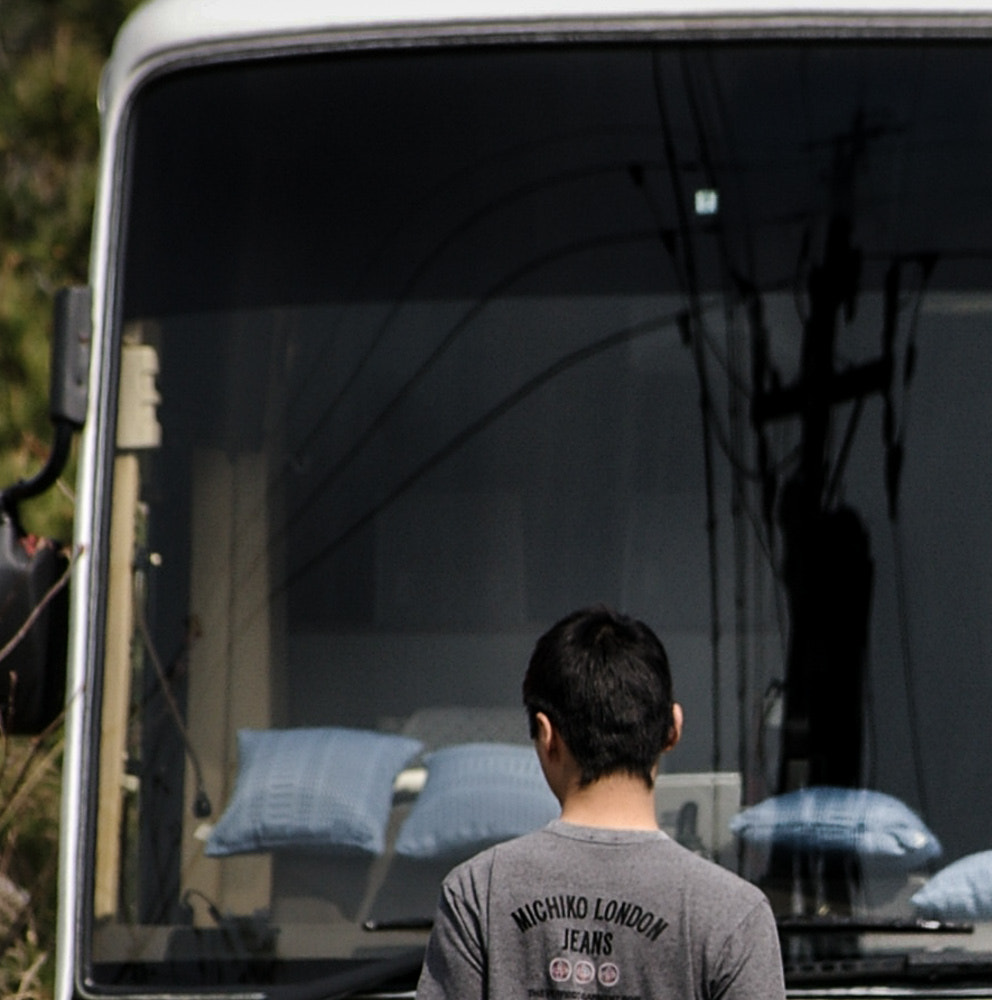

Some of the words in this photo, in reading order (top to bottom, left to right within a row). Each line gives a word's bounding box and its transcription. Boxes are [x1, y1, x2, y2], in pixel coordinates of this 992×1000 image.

[511, 894, 588, 933] MICHIKO
[594, 898, 669, 942] LONDON
[562, 928, 614, 956] JEANS
